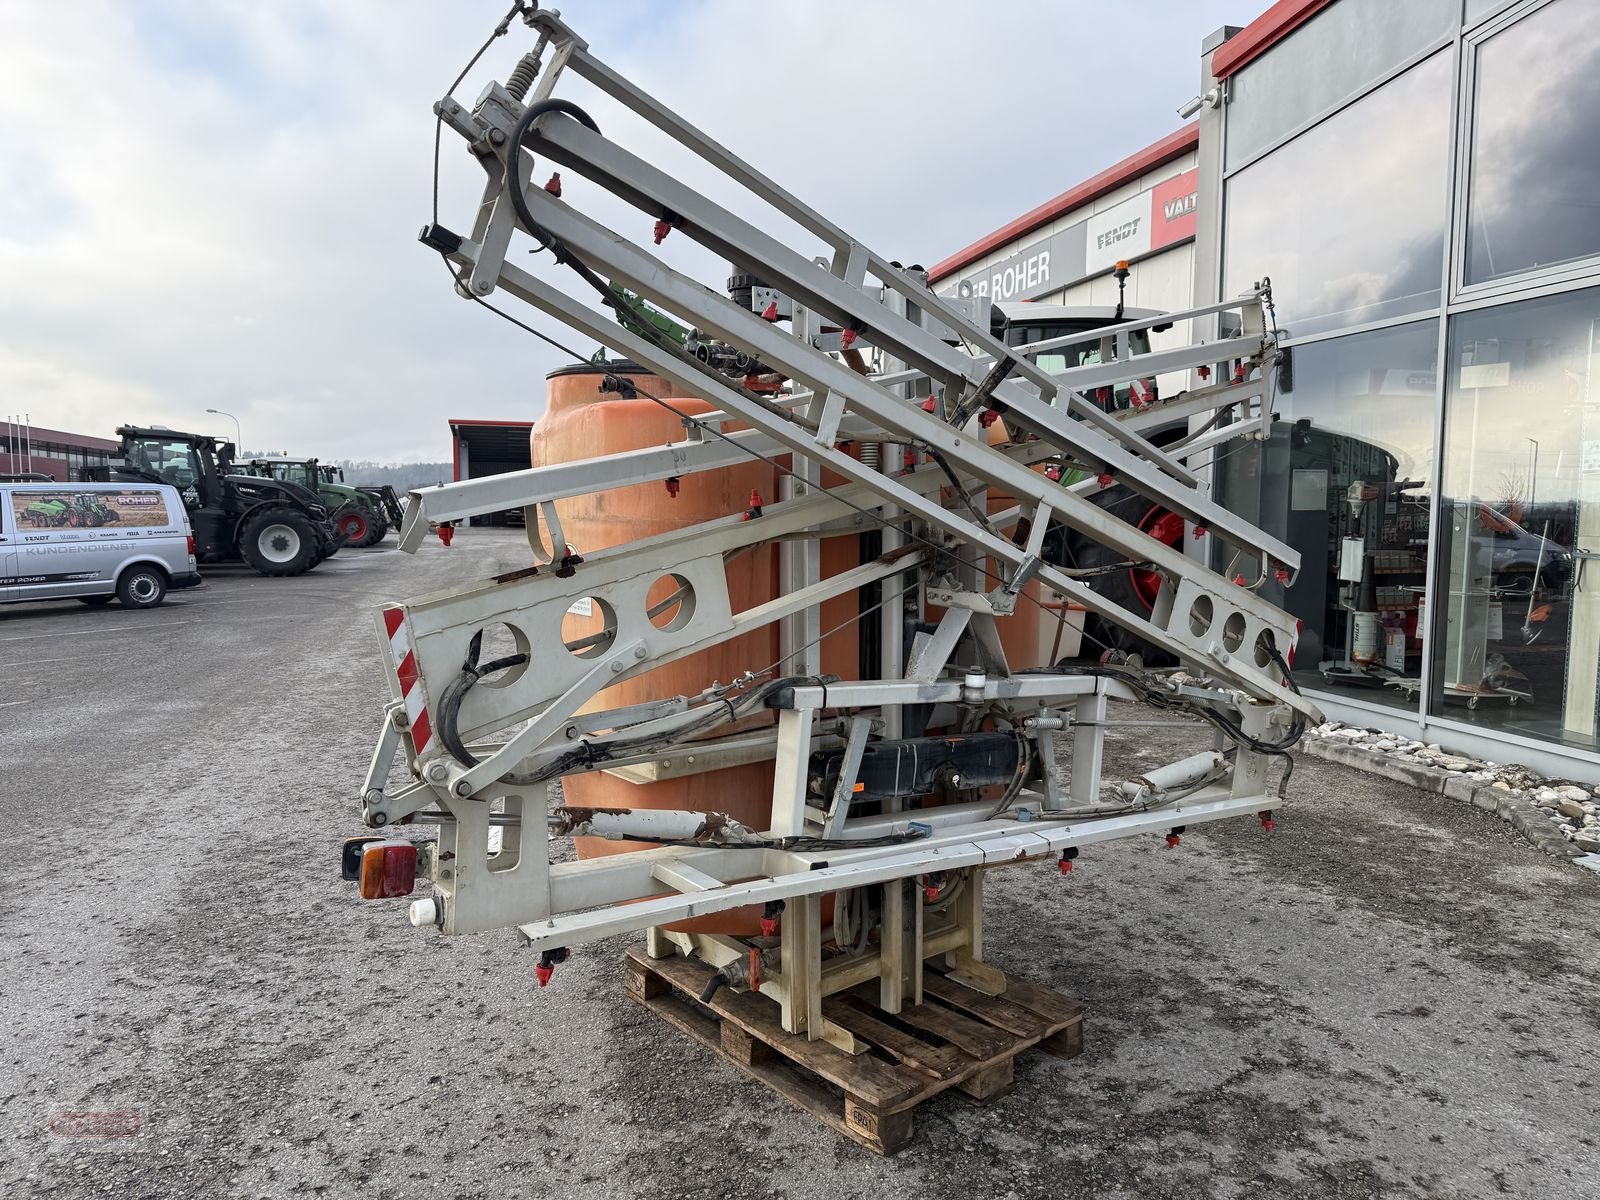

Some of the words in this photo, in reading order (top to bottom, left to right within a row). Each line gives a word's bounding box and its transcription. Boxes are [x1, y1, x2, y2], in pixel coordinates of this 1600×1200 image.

[1096, 217, 1141, 250] FENDT
[991, 251, 1050, 304] ROHER
[118, 497, 158, 505] ROHER
[26, 543, 137, 556] KUNDENDIENST
